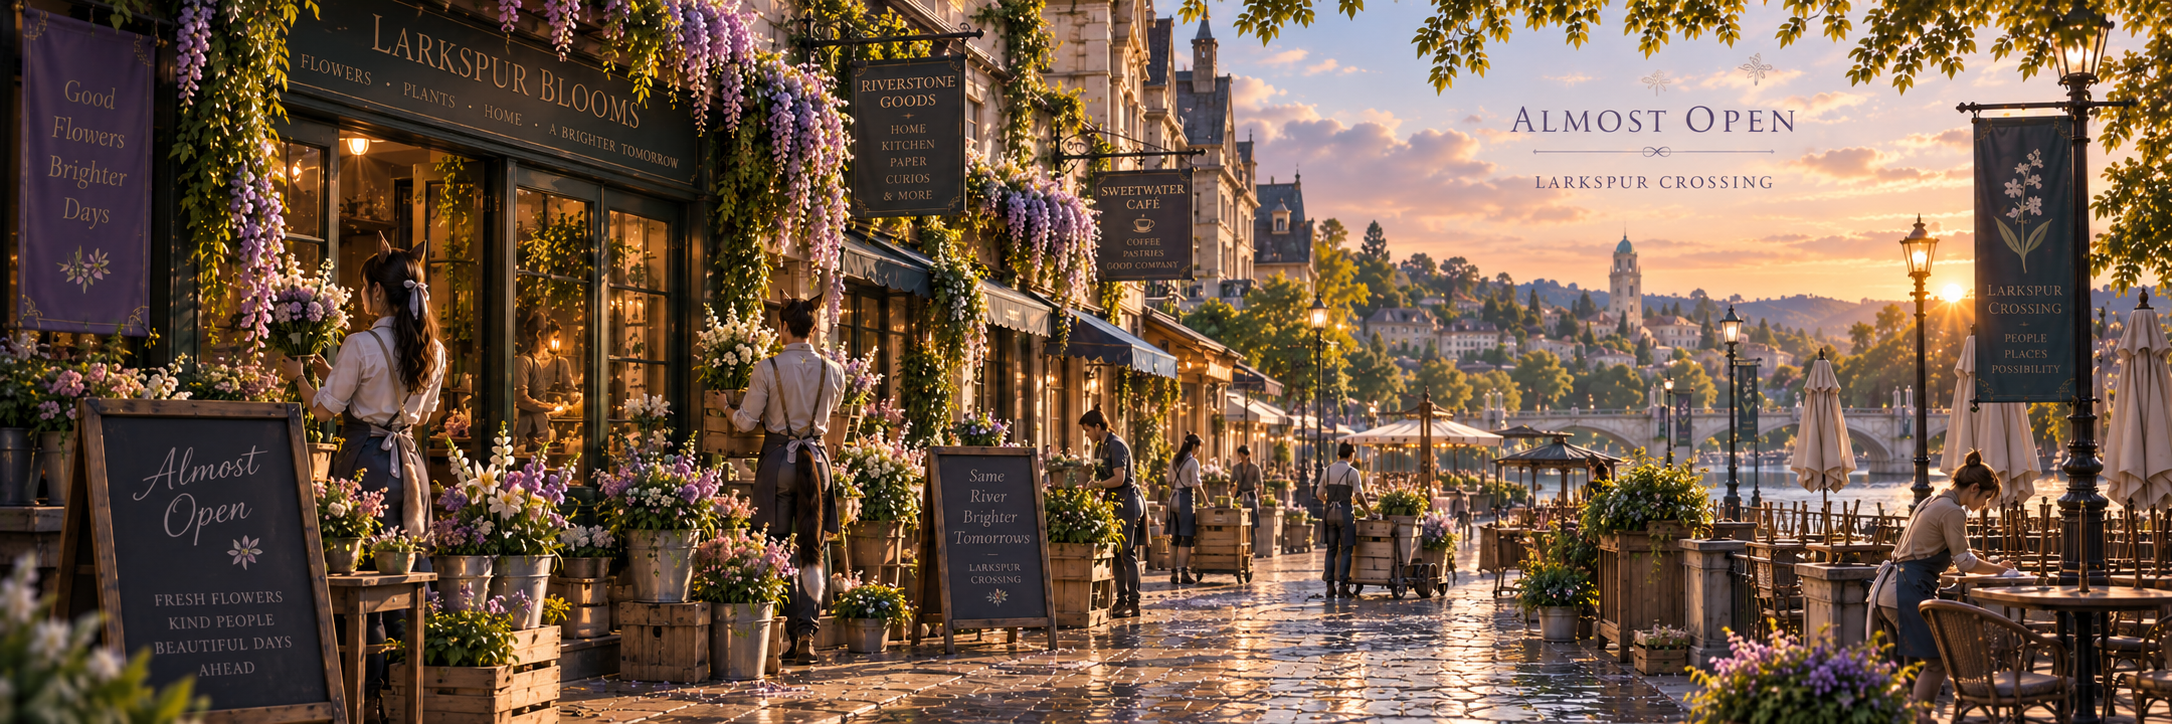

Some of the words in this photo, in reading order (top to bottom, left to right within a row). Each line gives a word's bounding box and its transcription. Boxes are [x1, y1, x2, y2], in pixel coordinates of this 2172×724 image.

[371, 12, 529, 97] LARKSPUR
[539, 67, 640, 129] BLOOMS
[860, 75, 956, 92] RIVERSTONE
[64, 79, 116, 110] Good
[880, 93, 936, 109] GOODS
[300, 53, 372, 86] FLOWERS
[403, 81, 456, 109] PLANTS
[484, 103, 522, 126] HOME
[548, 123, 557, 136] A
[561, 126, 616, 153] BRIGHTER
[620, 143, 679, 169] TOMORROW
[51, 115, 125, 149] Flowers
[891, 123, 927, 135] HOME
[881, 139, 935, 151] KITCHEN
[890, 156, 927, 167] PAPER
[48, 154, 127, 189] Brighter
[885, 173, 930, 184] CURIOS
[883, 191, 893, 201] &
[898, 190, 933, 200] MORE
[1101, 184, 1185, 197] SWEETWATER
[1126, 196, 1160, 210] CAFÉ
[63, 196, 110, 230] Days
[1126, 237, 1161, 246] COFFEE
[1123, 249, 1164, 257] PASTRIES
[1106, 261, 1132, 270] GOOD
[1134, 260, 1179, 270] COMPANY
[1987, 284, 2063, 296] LARKSPUR
[1988, 301, 2062, 315] CROSSING
[2004, 333, 2047, 343] PEOPLE
[2004, 349, 2048, 359] PLACES
[1991, 364, 2061, 374] POSSIBILITY
[132, 444, 268, 501] Almost
[969, 468, 1005, 482] Same
[970, 489, 1007, 503] River
[163, 492, 252, 546] Open
[963, 509, 1018, 527] Brighter
[953, 530, 1031, 545] Tomorrows
[969, 563, 1021, 572] LARKSPUR
[970, 575, 1022, 584] CROSSING
[154, 592, 206, 607] FRESH
[211, 590, 283, 605] FLOWERS
[168, 616, 211, 630] KIND
[216, 613, 275, 628] PEOPLE
[154, 638, 248, 655] BEAUTIFUL
[253, 635, 293, 651] DAYS
[198, 661, 255, 678] AHEAD
